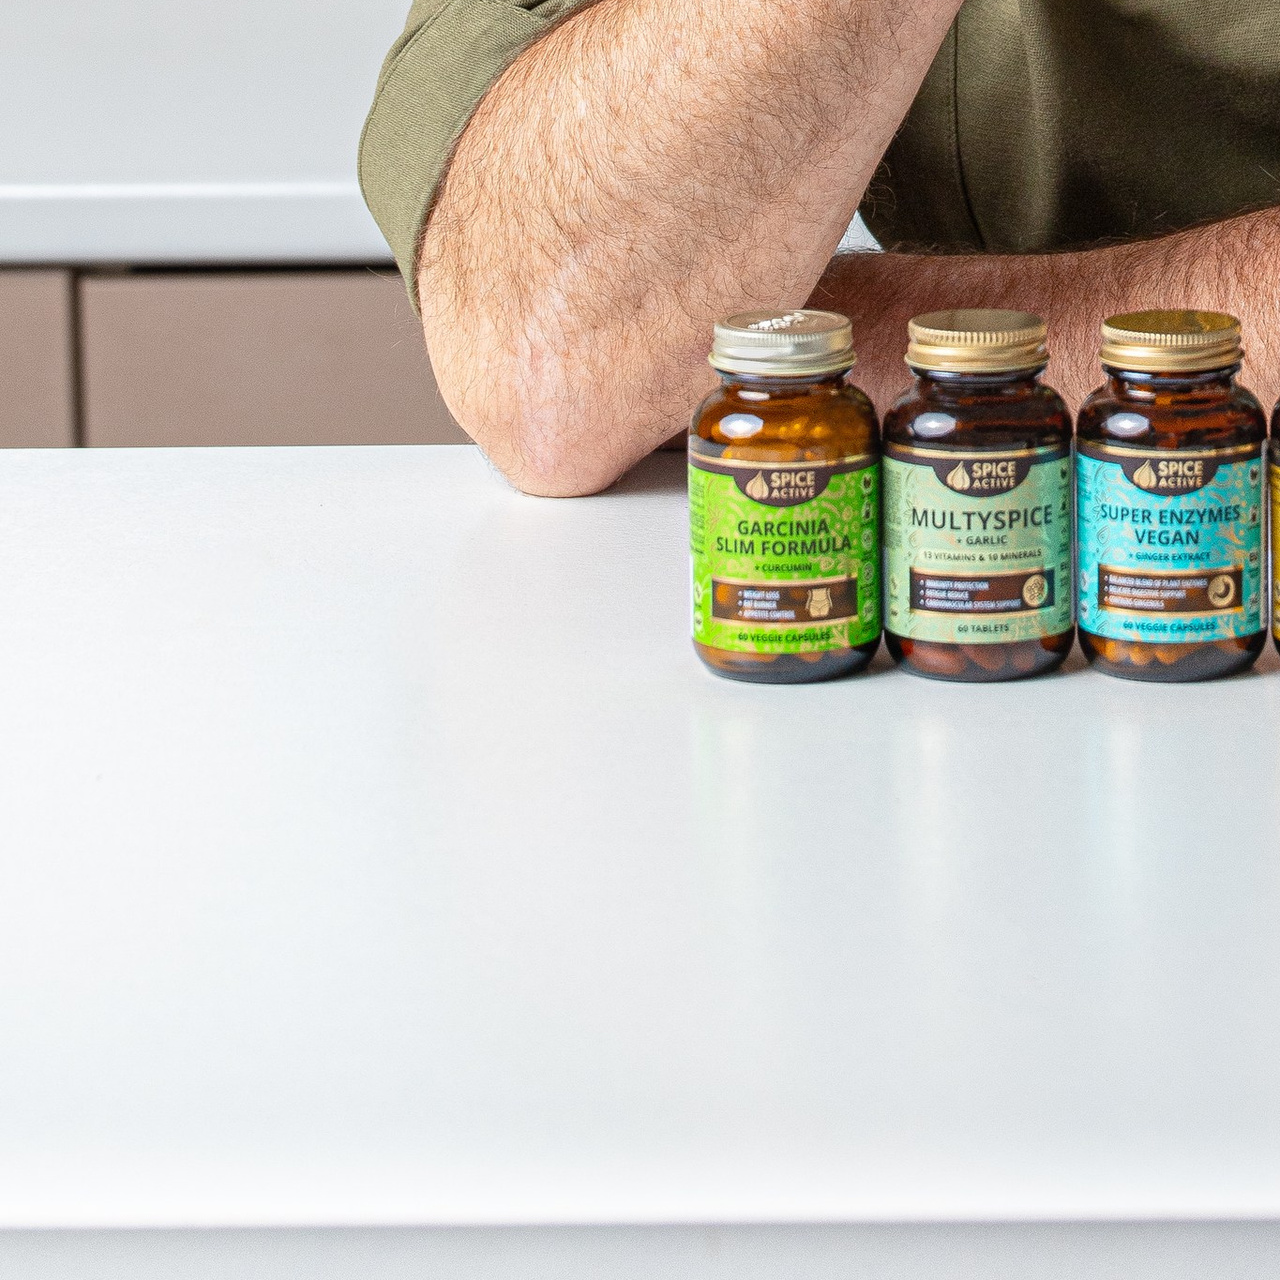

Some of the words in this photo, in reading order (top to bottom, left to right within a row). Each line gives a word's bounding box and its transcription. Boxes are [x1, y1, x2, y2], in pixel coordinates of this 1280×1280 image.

[972, 461, 1016, 478] SPICE
[1158, 461, 1203, 477] SPICE
[771, 471, 815, 488] SPICE
[972, 477, 1016, 488] ACTIVE
[1158, 476, 1203, 488] ACTIVE
[771, 488, 815, 499] ACTIVE
[911, 504, 1053, 530] MULTYSPICE
[1100, 503, 1152, 524] SUPER
[1158, 504, 1241, 525] ENZYMES
[738, 520, 829, 537] GARCINIA
[966, 535, 1008, 545] GARLIC
[1134, 529, 1200, 545] VEGAN
[717, 536, 754, 555] SLIM
[761, 535, 851, 556] FORMULA
[934, 552, 976, 562] VITAMINS
[1000, 549, 1042, 561] MINERALS
[1136, 551, 1169, 561] GINGER
[1172, 551, 1211, 561] EXTRACT
[762, 562, 812, 572] CURCUMIN
[957, 624, 968, 633] 60
[971, 624, 1009, 633] TABLETS
[1136, 622, 1168, 632] VEGGIE
[1170, 621, 1216, 632] CAPSULES
[738, 632, 748, 641] 60
[749, 633, 781, 642] VEGGIE
[784, 632, 831, 642] CAPSULES
